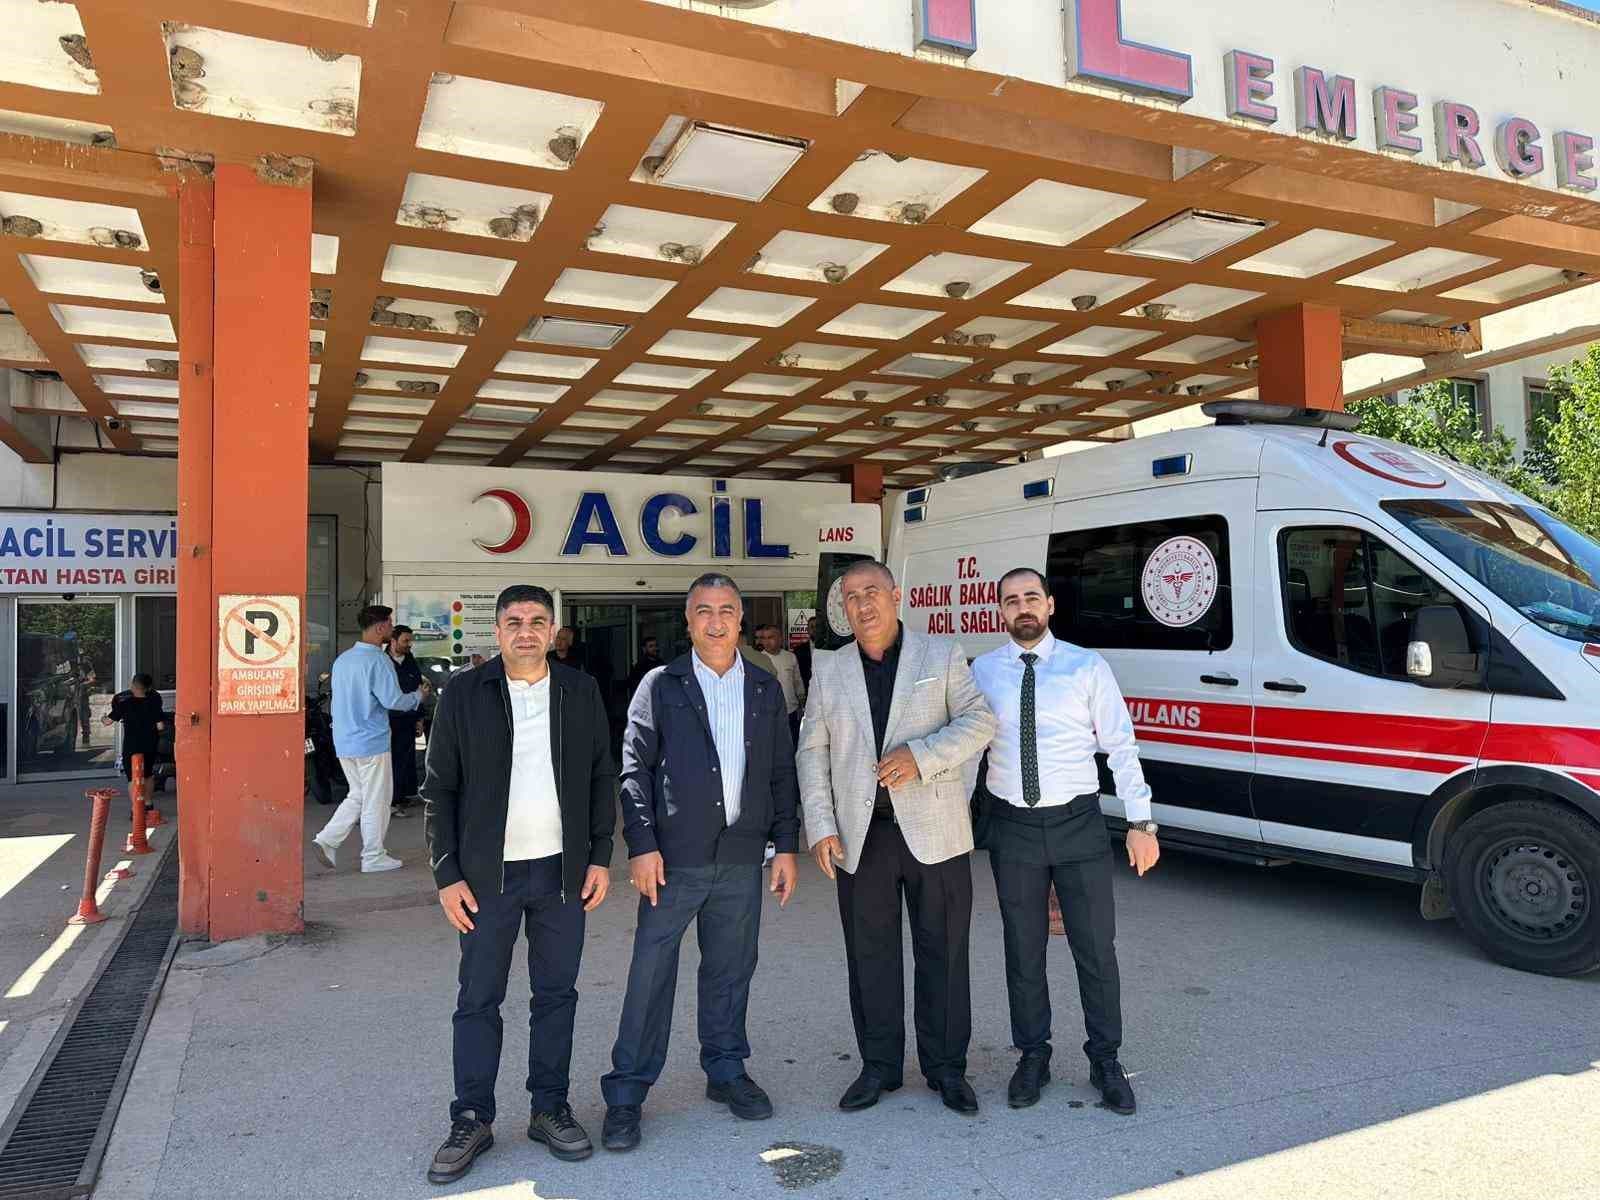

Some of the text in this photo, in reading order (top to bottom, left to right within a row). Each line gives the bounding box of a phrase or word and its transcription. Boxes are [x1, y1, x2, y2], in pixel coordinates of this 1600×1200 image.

[1224, 49, 1599, 194] EMERGE
[560, 479, 790, 558] ACİL
[0, 519, 75, 557] ACİL
[818, 527, 854, 542] LANS
[56, 569, 126, 585] HASTA
[957, 556, 980, 579] T.C.
[910, 584, 952, 608] SAĞLIK
[928, 608, 956, 635] ACİL
[231, 669, 286, 681] AMBULANS
[221, 700, 246, 712] PARK
[1128, 702, 1201, 728] ULANS
